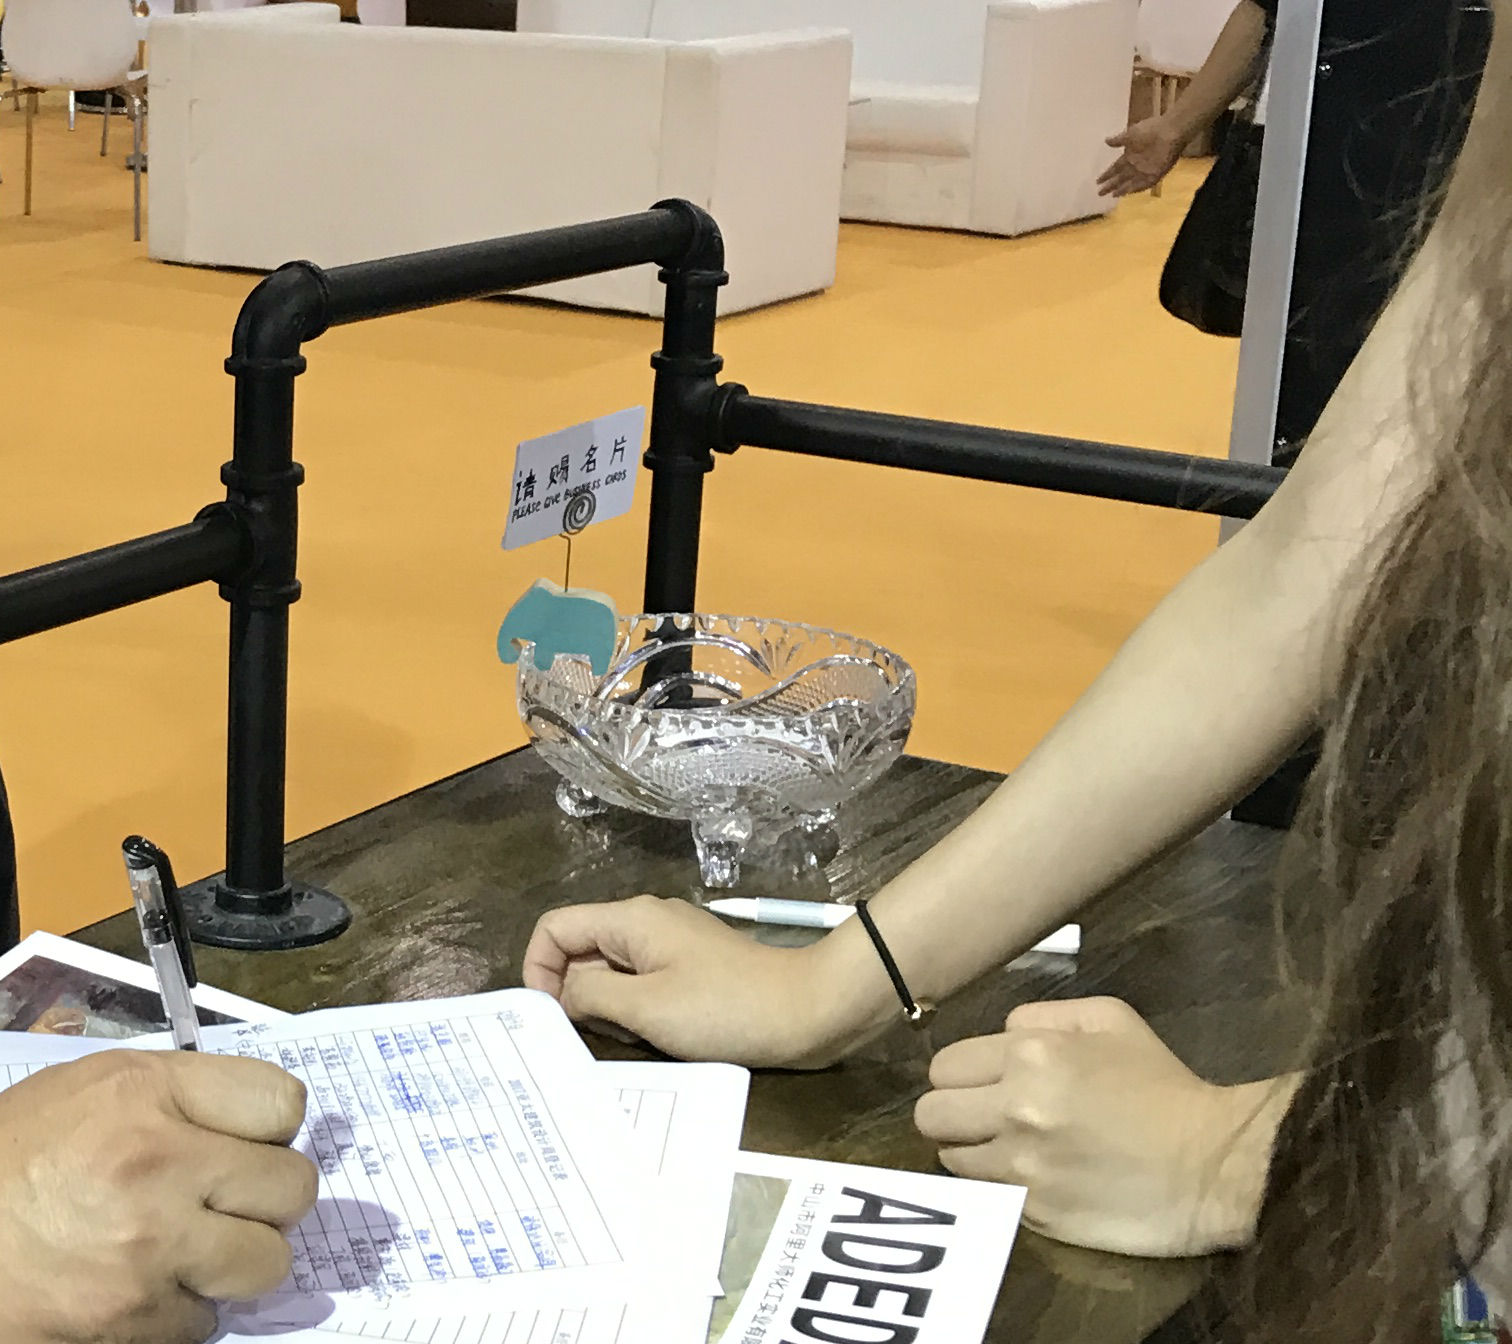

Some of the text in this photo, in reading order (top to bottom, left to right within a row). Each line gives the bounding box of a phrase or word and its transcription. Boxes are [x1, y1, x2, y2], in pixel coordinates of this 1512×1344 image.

[514, 436, 627, 506] 请赐名片
[511, 500, 541, 524] PLEASE
